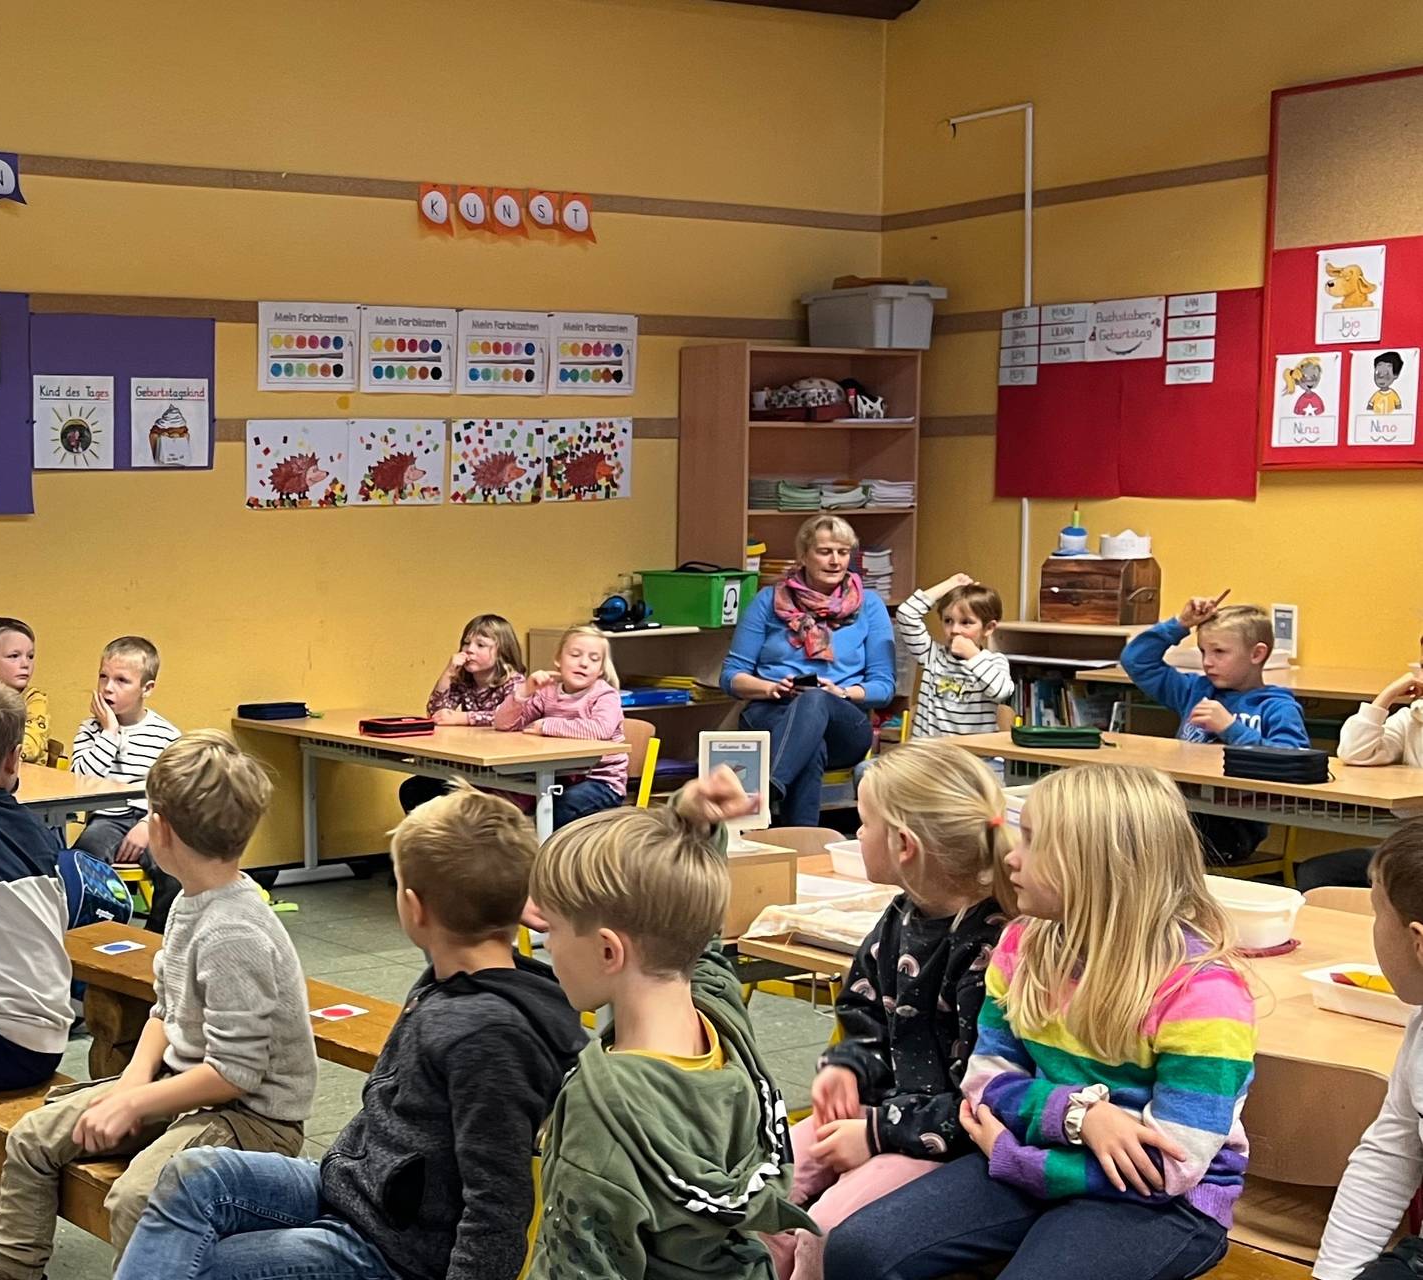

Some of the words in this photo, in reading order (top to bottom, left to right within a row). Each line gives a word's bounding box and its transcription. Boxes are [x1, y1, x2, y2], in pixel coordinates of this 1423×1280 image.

[274, 312, 297, 322] Mein
[376, 316, 396, 326] Mein
[1098, 330, 1152, 342] Geburtstag
[40, 385, 60, 397] Kind
[65, 386, 80, 397] des
[86, 386, 109, 400] Tages
[135, 386, 205, 400] Geburtstagskind
[1293, 422, 1320, 434] Nina
[1370, 420, 1397, 433] Nino
